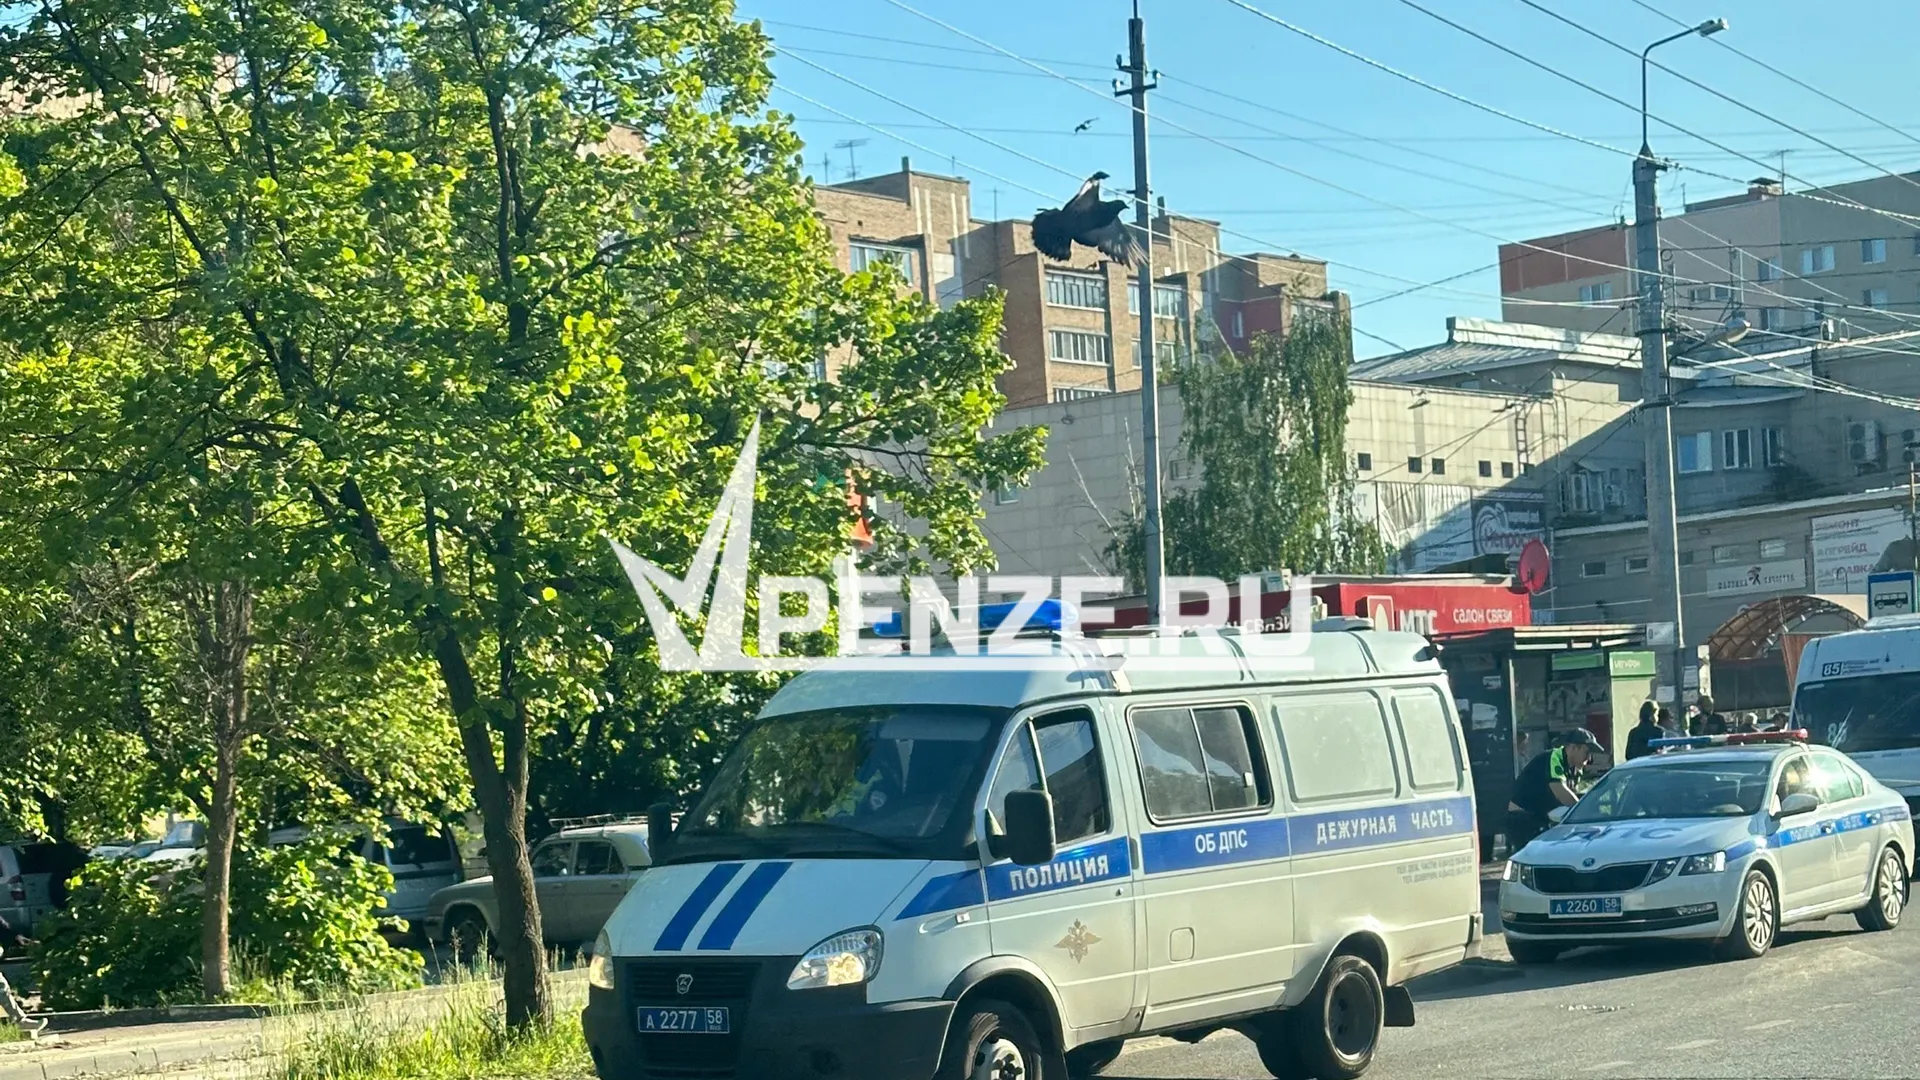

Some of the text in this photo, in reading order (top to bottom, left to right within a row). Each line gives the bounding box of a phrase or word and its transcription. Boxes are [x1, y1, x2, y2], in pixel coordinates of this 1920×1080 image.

[1400, 609, 1439, 634] МТС
[1823, 663, 1840, 676] 85
[1316, 808, 1454, 845] ДЕЖУРНАЯ ЧАСТЬ
[1195, 828, 1249, 854] ОБ ДПС
[1009, 854, 1110, 892] ПОЛИЦИЯ
[1566, 900, 1597, 914] 2260
[1604, 898, 1618, 908] 58
[660, 1010, 697, 1030] 2277
[707, 1009, 723, 1024] 58
